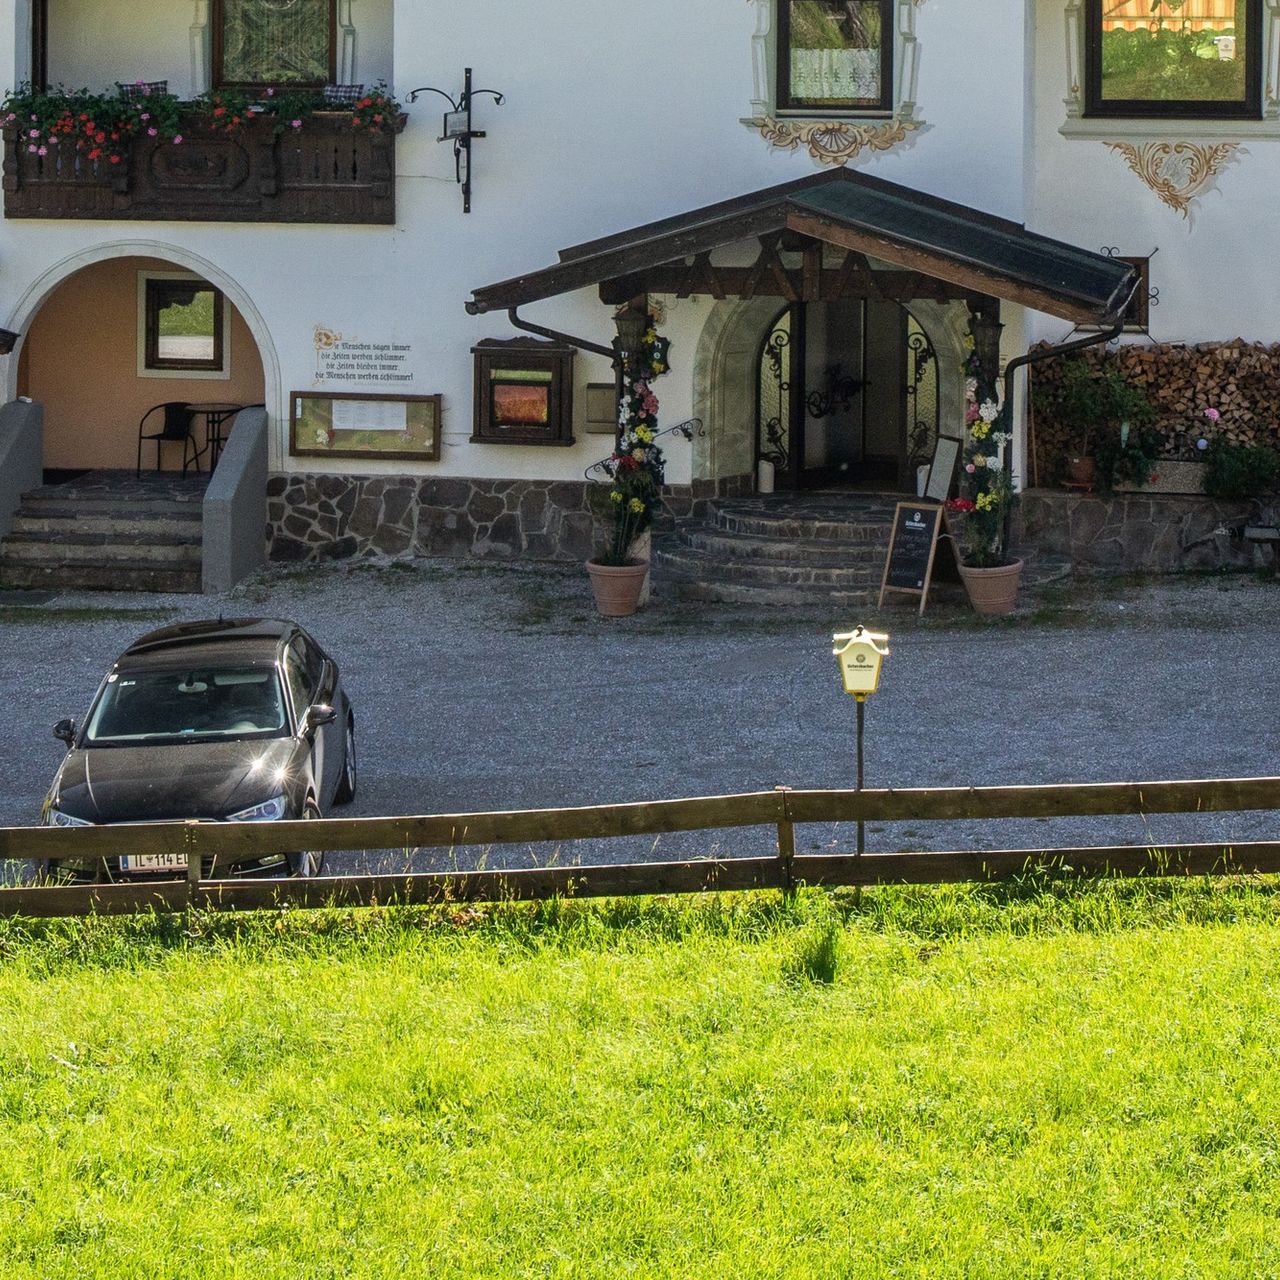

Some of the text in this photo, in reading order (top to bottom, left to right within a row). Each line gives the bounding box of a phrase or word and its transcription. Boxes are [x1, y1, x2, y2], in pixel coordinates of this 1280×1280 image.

[341, 342, 371, 351] Menschen
[372, 343, 391, 352] sagen
[331, 351, 350, 361] Zeiten
[351, 352, 373, 361] werden
[336, 361, 355, 371] Zeiten
[356, 362, 378, 370] bleiben
[325, 371, 356, 381] Menschen
[357, 372, 379, 381] werden
[155, 853, 173, 867] 114
